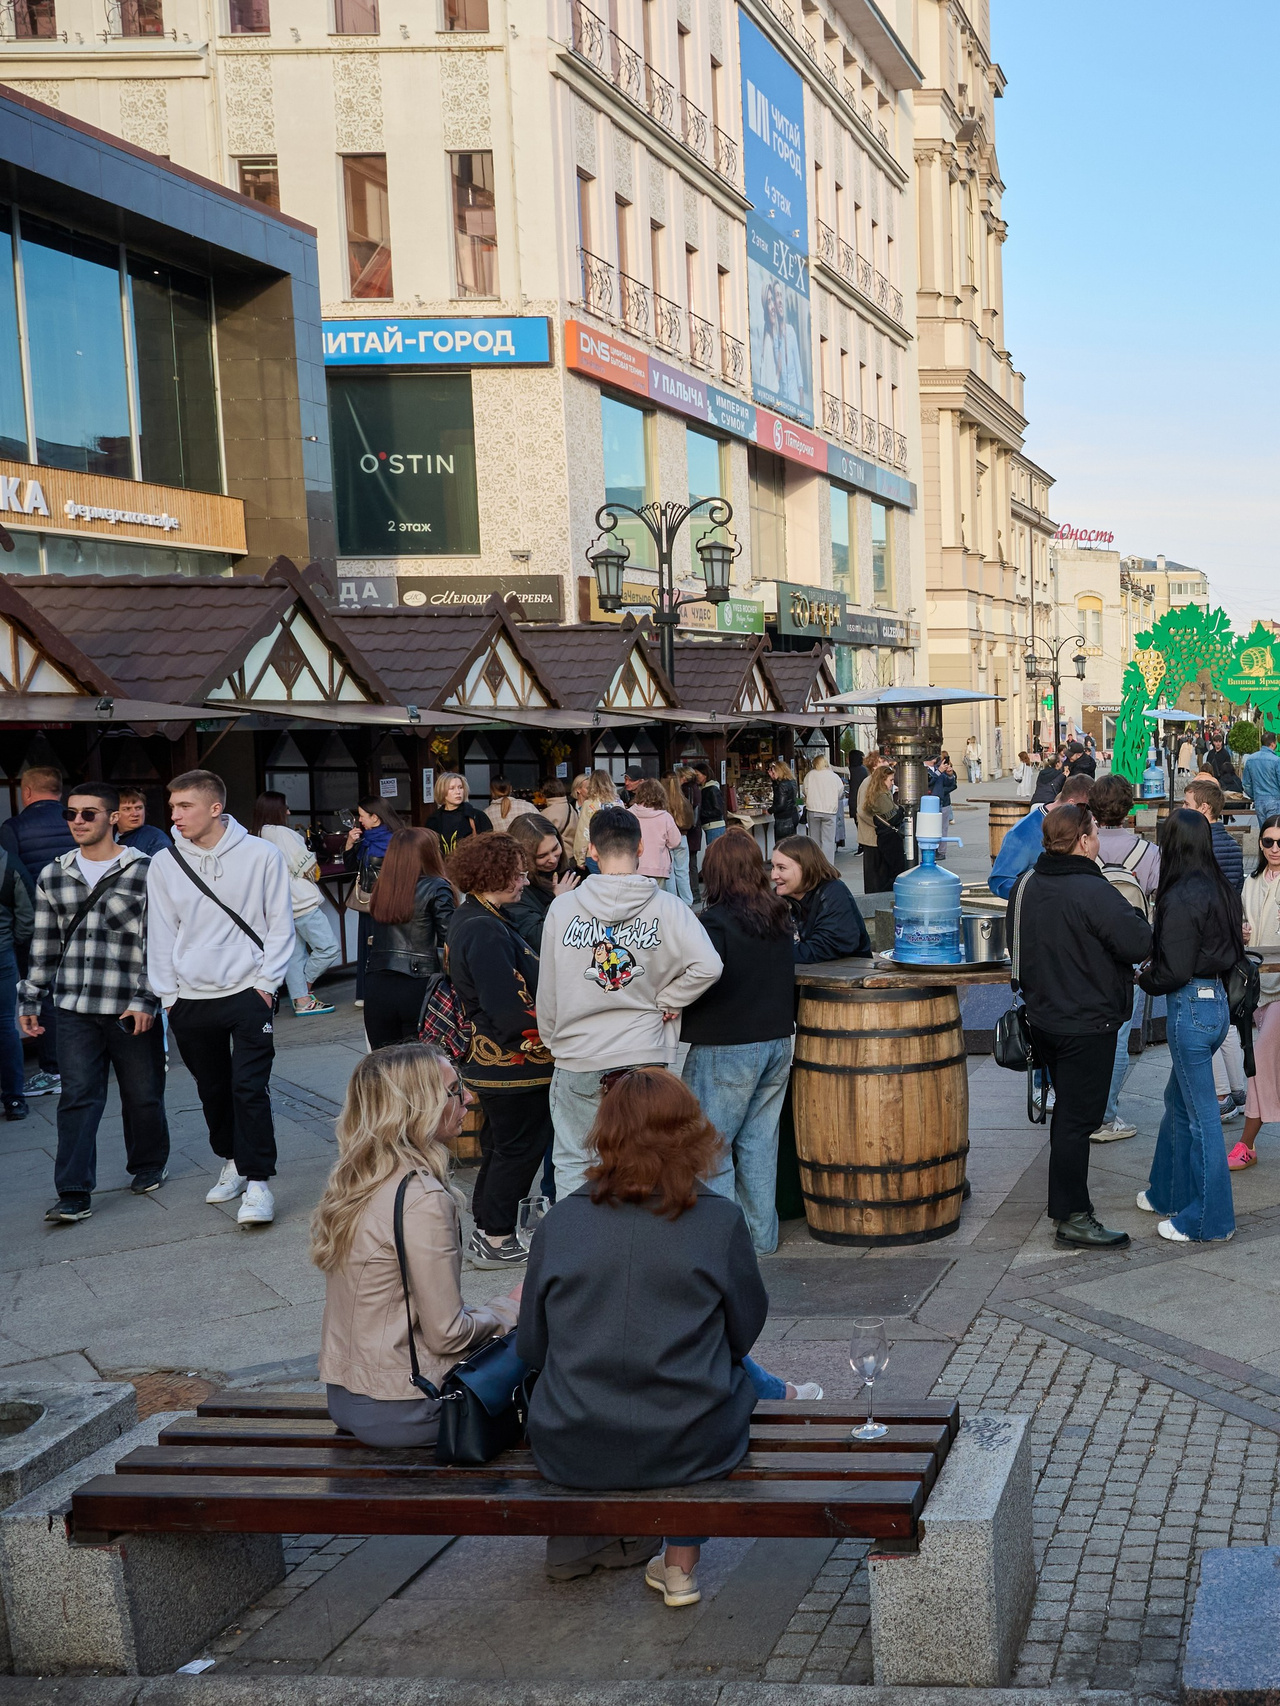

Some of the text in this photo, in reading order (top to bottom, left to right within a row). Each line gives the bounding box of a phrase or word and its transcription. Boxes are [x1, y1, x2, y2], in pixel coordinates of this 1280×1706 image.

[771, 103, 801, 152] ЧИТАЙ
[772, 130, 803, 182] ГОРОД
[764, 175, 792, 218] 4 этаж
[751, 229, 756, 244] 2
[580, 331, 611, 363] DNS
[652, 370, 660, 389] У
[662, 375, 704, 409] ПАЛЫЧА
[715, 394, 750, 420] ИМПЕРИЯ
[720, 412, 746, 434] СУМОК
[388, 520, 432, 532] 2 этаж
[691, 608, 712, 622] ЧУДЕС
[1227, 677, 1256, 685] Винная
